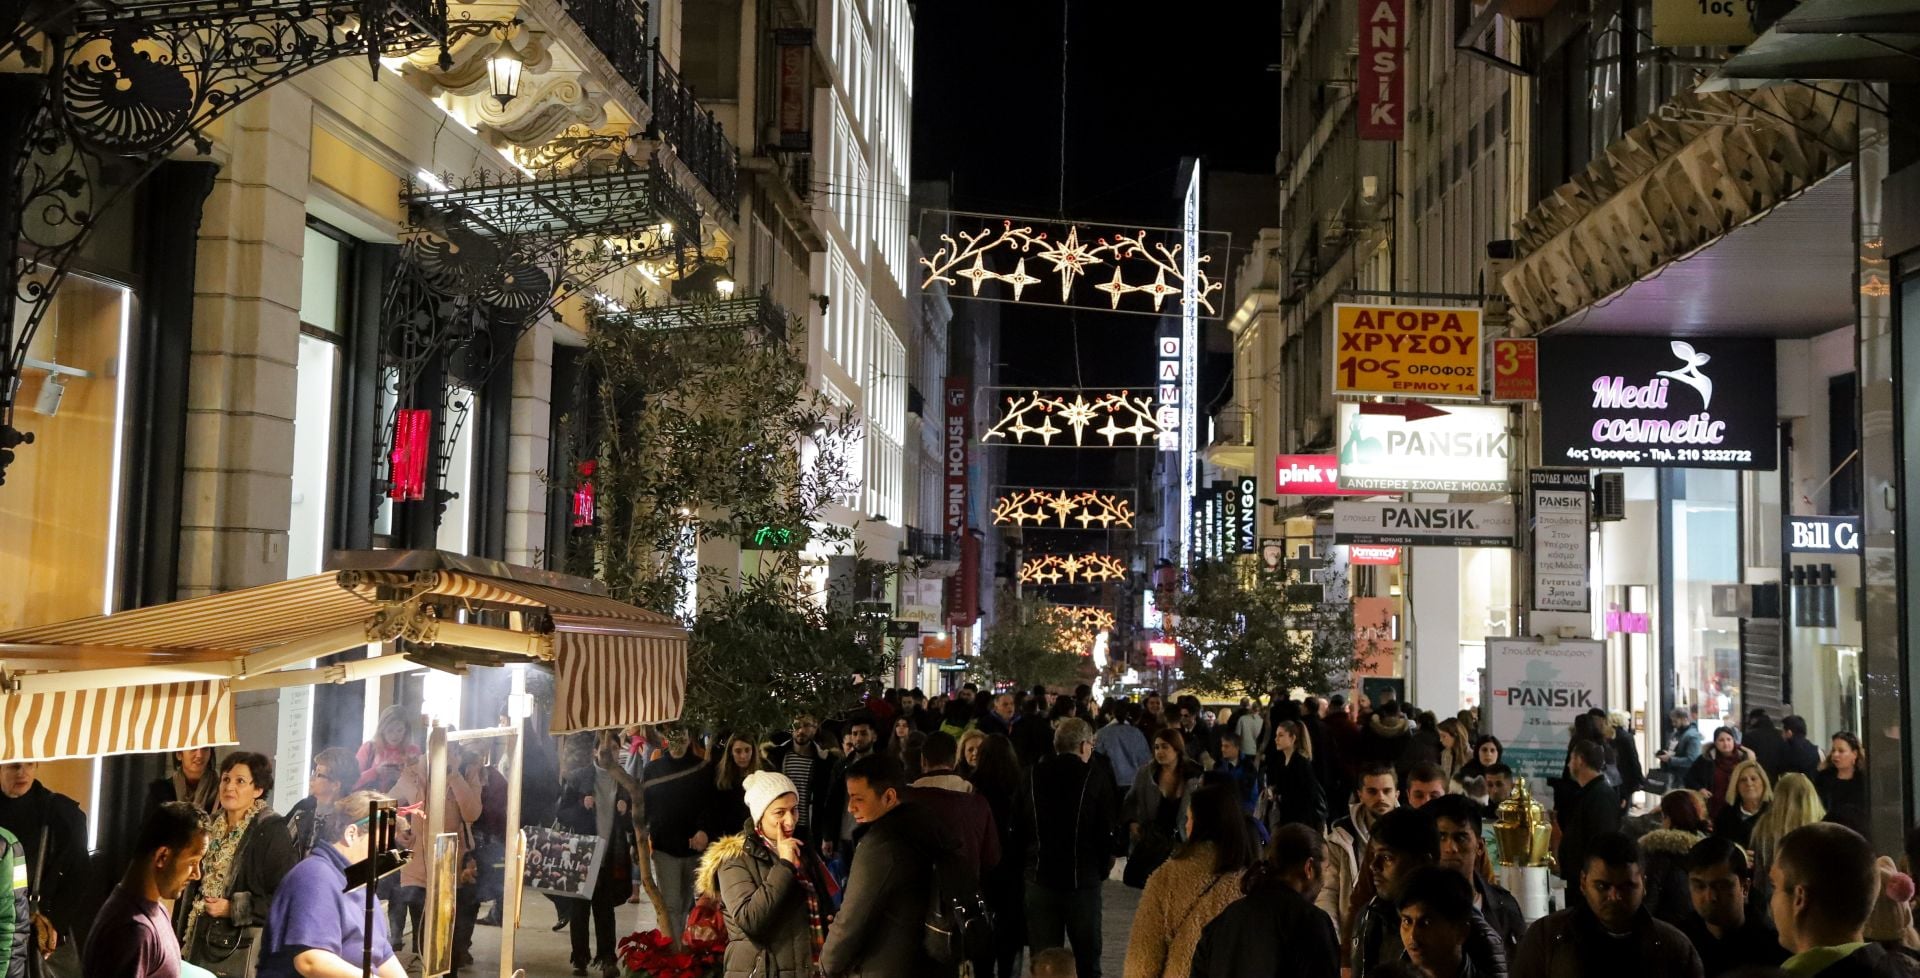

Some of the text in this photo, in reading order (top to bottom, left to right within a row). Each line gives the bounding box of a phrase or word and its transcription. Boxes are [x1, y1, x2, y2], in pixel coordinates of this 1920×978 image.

[1353, 310, 1464, 332] ΑΓΟΡΑ
[1340, 332, 1475, 355] ΧΡΥΣΟΥ
[1340, 356, 1475, 388] 1ος ΟΡΟΦΟΣ
[1392, 380, 1475, 392] ΕΡΜΟΥ 14
[1592, 375, 1670, 409] Medi
[1592, 412, 1726, 444] cosmetic
[950, 416, 964, 476] HOUSE
[1566, 447, 1589, 461] 4ος
[1591, 447, 1641, 461] Όροφος
[1650, 449, 1675, 462] Τηλ.
[1678, 449, 1700, 461] 210
[1702, 450, 1752, 462] 3232722
[1279, 464, 1323, 486] pink
[1347, 479, 1505, 492] ΑΝΩΤΕΡΕΣ ΣΧΟΛΕΣ ΜΟΔΑΣ
[1532, 473, 1587, 485] ΣΠΟΥΔΕΣ ΜΟΔΑΣ
[1225, 489, 1236, 553] MANGO
[1241, 480, 1254, 550] MANGO
[1791, 522, 1831, 548] Bill
[1351, 546, 1397, 558] Yamamay
